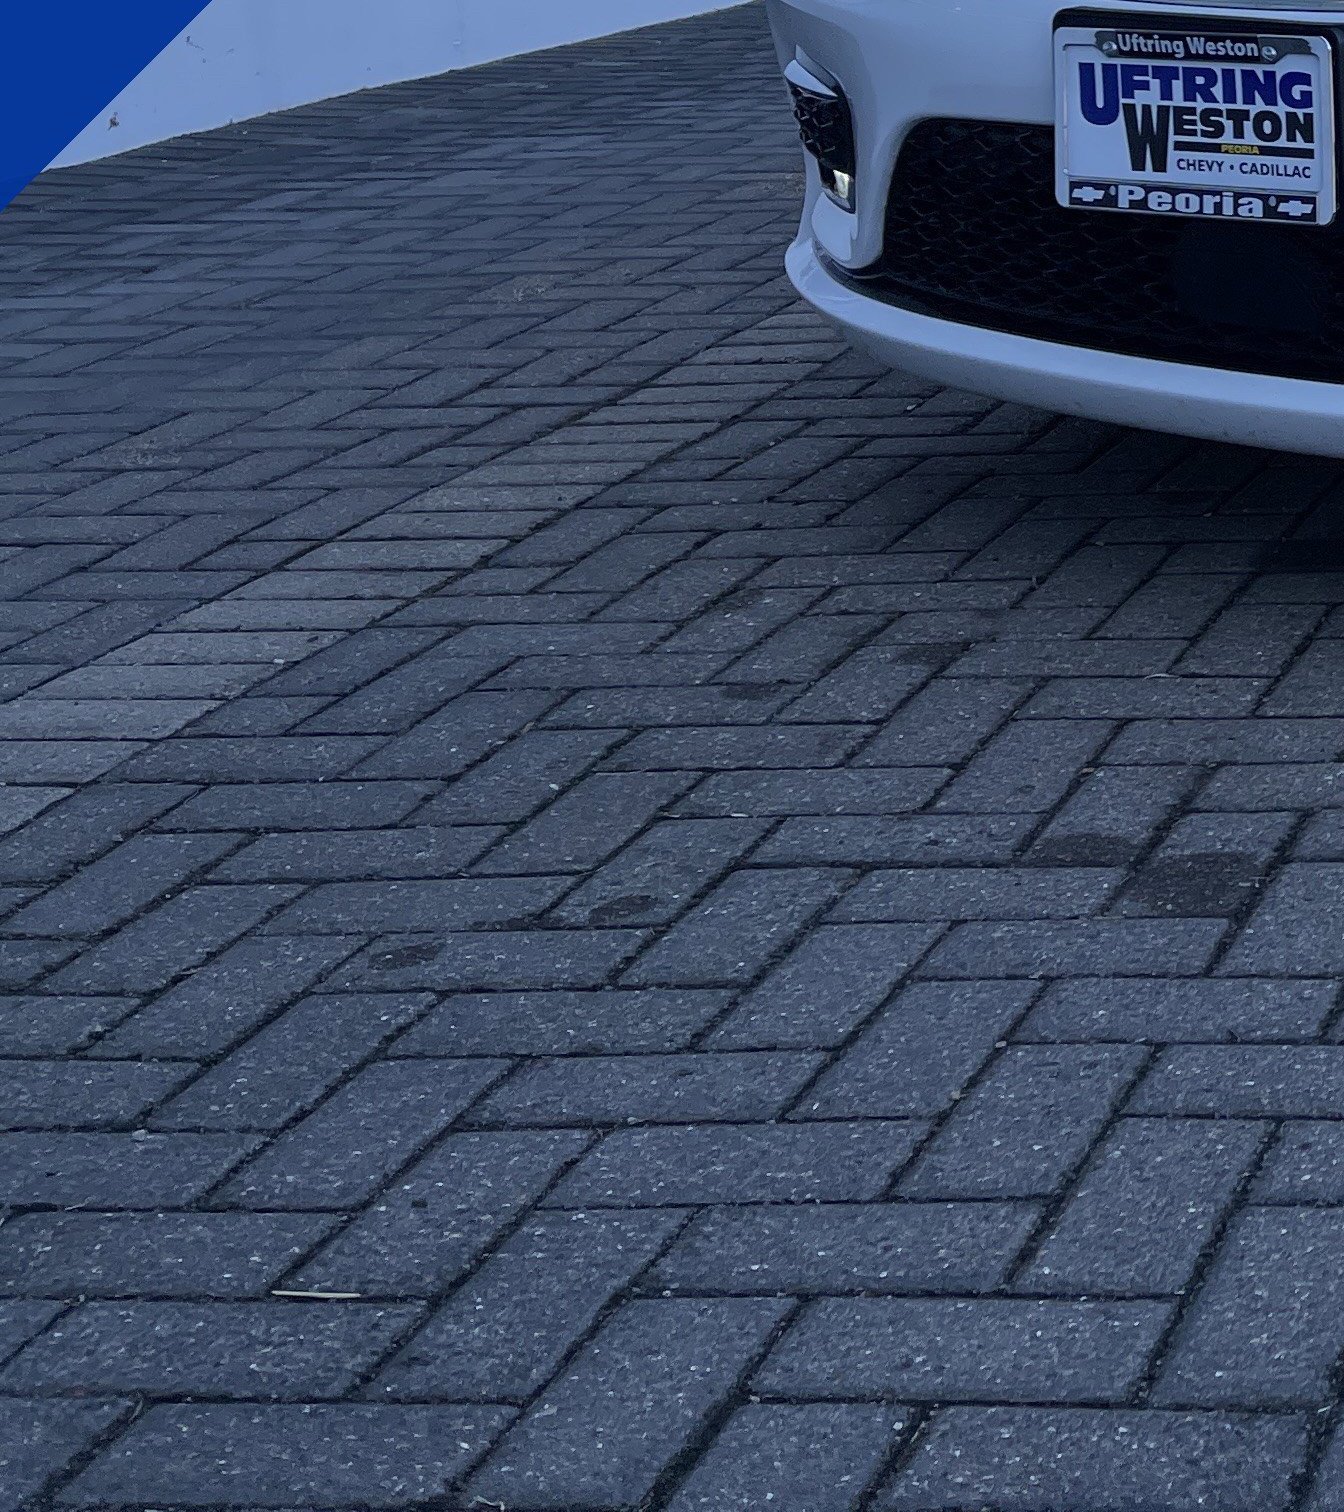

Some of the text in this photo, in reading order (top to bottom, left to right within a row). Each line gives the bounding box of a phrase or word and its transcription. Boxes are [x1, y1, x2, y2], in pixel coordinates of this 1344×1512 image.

[1116, 33, 1259, 59] Uftring Weston
[1078, 61, 1314, 126] UFTRING
[1122, 102, 1315, 174] WESTON
[1220, 144, 1260, 155] PEORIA
[1176, 158, 1312, 179] CHEVY CADILLAC
[1117, 184, 1265, 218] Peoria
